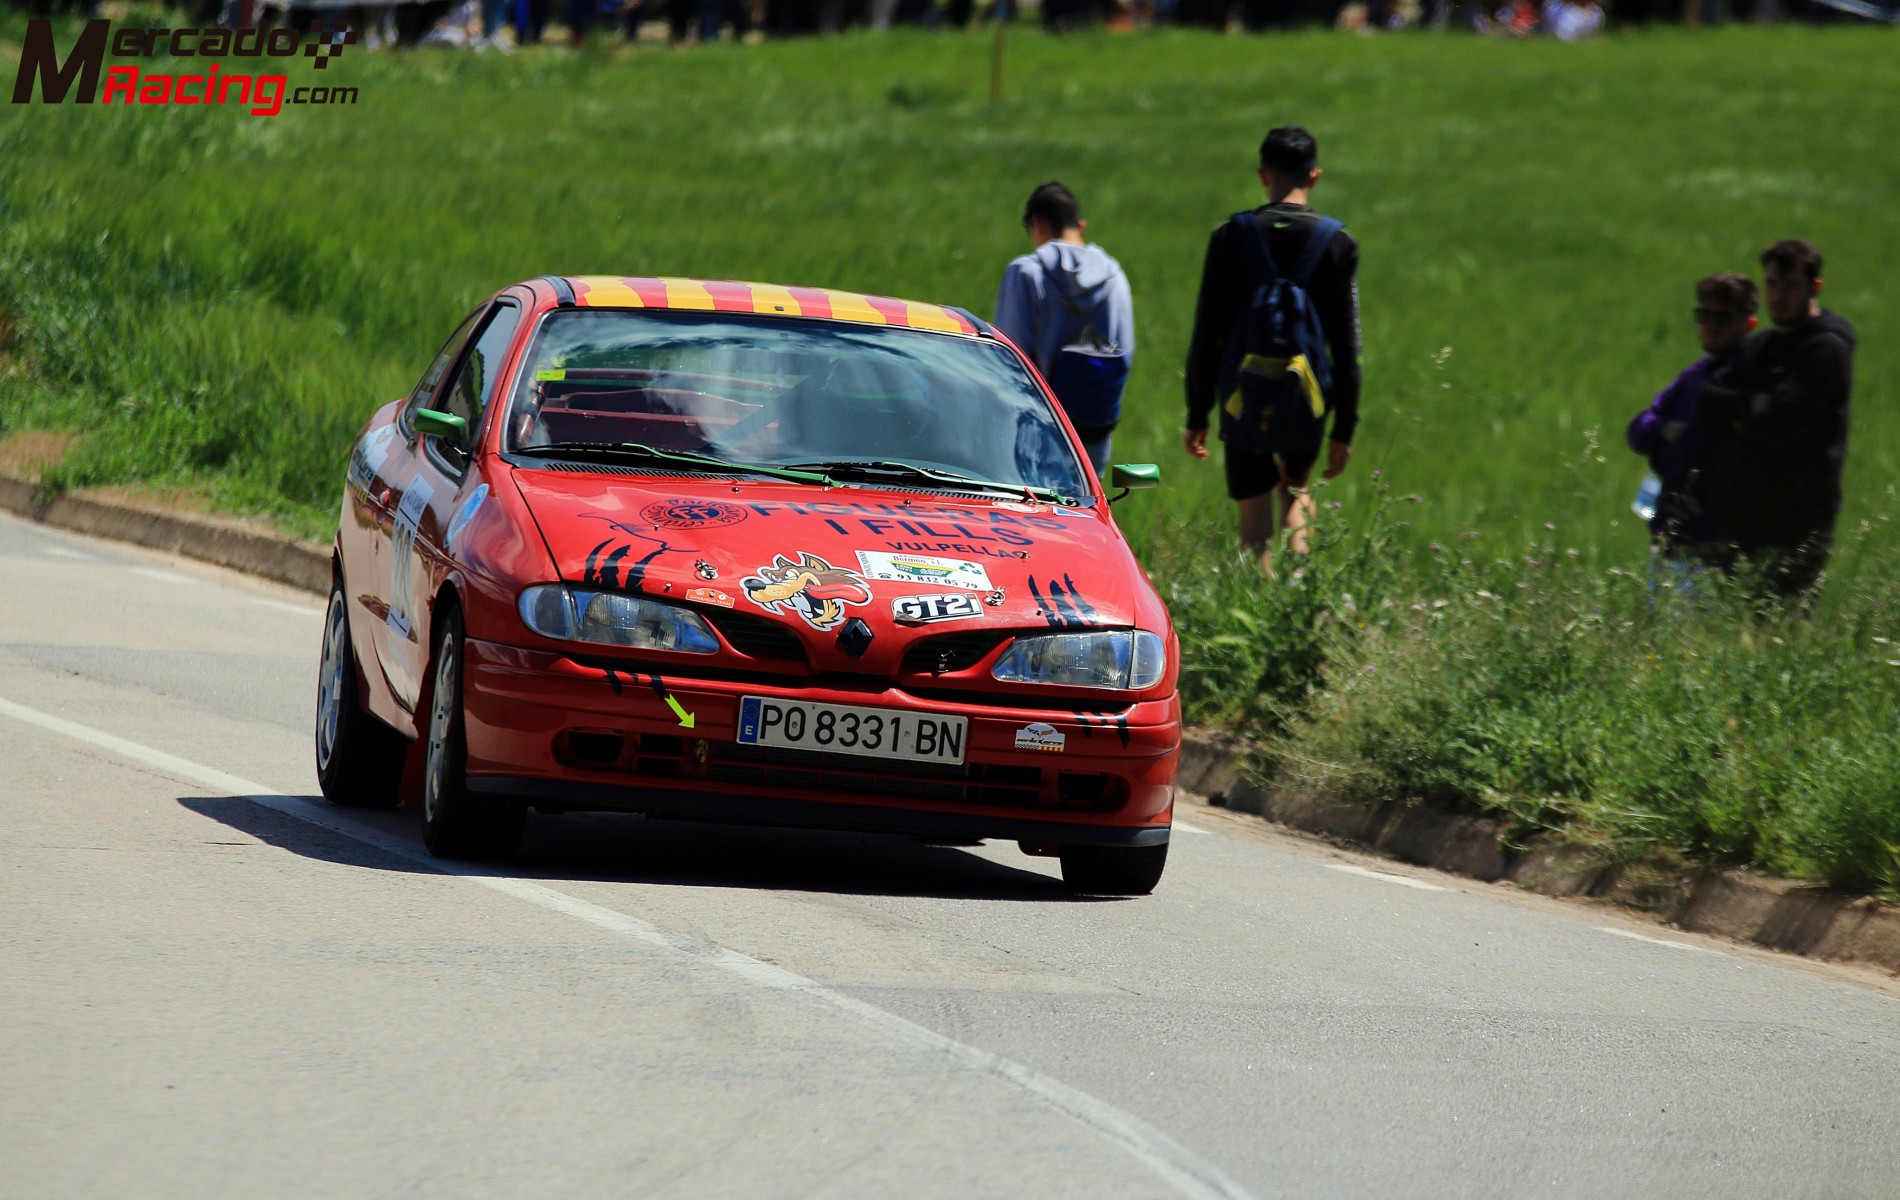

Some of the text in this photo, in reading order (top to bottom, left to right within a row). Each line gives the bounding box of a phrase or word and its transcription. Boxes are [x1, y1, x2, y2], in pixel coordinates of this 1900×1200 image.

[746, 502, 1067, 530] FIGUERAS
[824, 519, 1034, 546] I FILLS
[963, 581, 978, 589] 79
[893, 592, 982, 619] GT2i
[744, 725, 753, 736] E
[815, 710, 901, 752] 8331
[915, 719, 963, 758] BN
